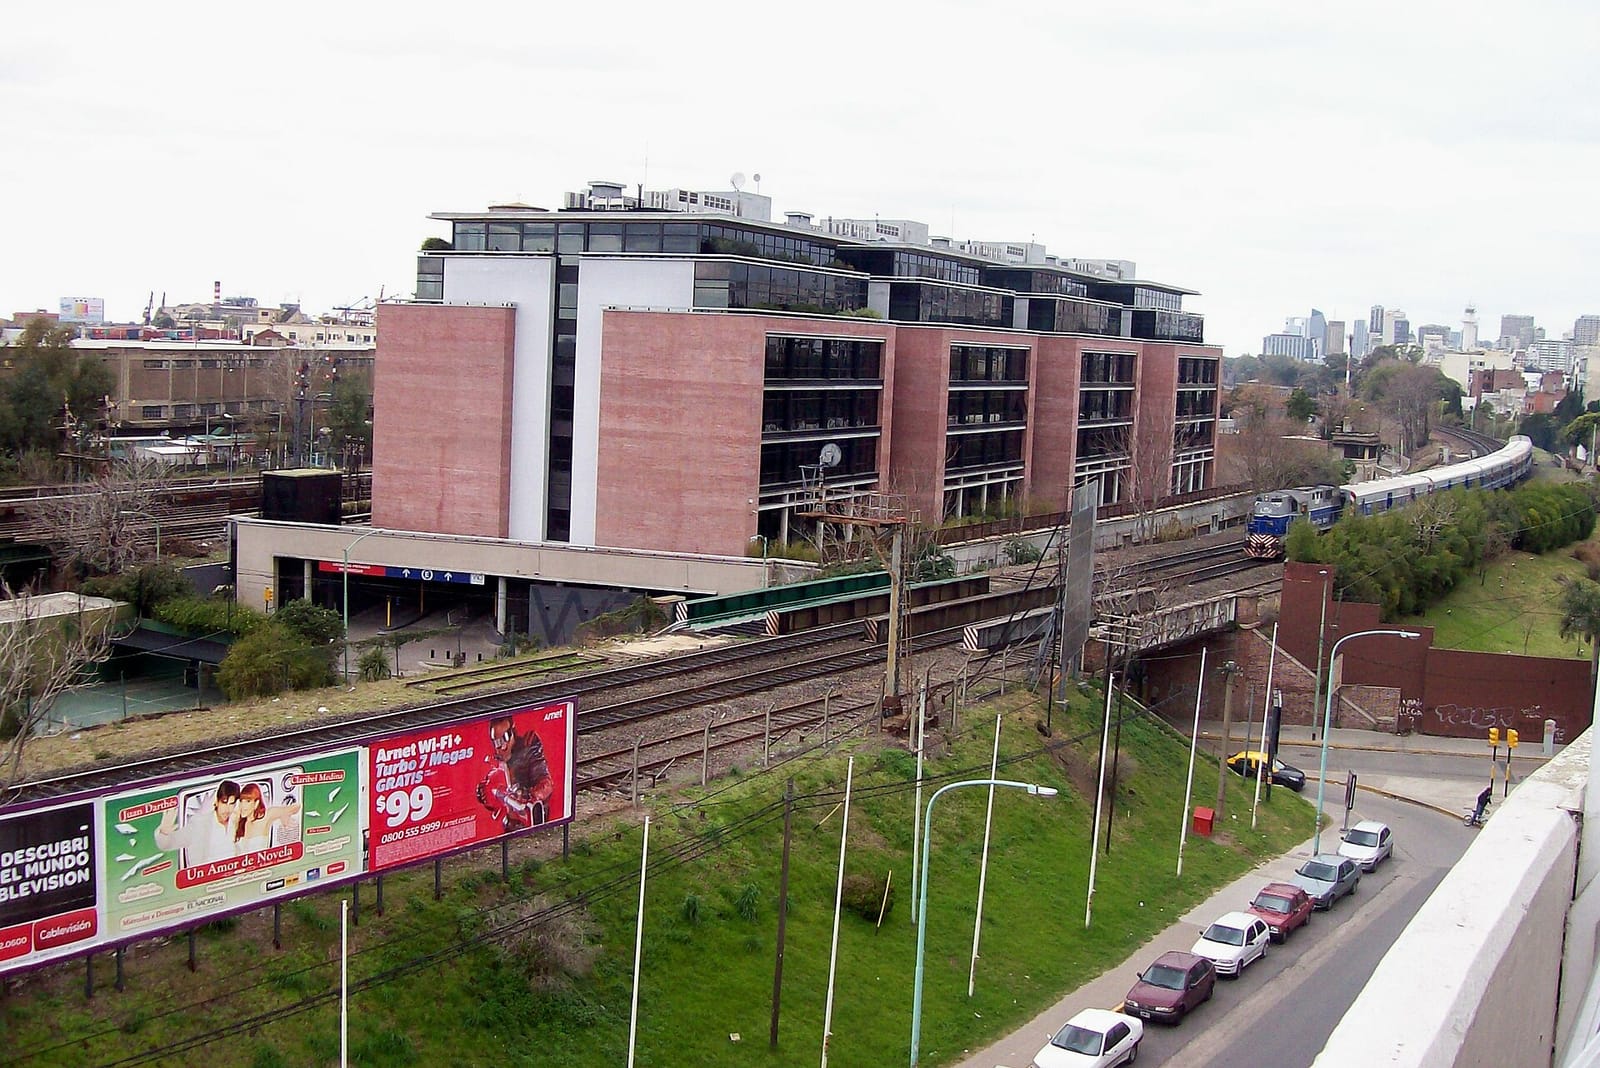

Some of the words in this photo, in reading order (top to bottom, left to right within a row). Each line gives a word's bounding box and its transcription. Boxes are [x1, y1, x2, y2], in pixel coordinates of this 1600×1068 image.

[376, 742, 416, 763] Arnet
[418, 734, 453, 754] Wi-Fi
[376, 758, 417, 777] Turbo
[418, 754, 428, 769] 7
[429, 747, 474, 767] Megas
[291, 774, 318, 785] Claribel
[319, 773, 344, 782] Medina
[375, 770, 424, 793] GRATIS
[122, 808, 143, 821] Juan
[144, 797, 178, 814] Darthés
[376, 785, 433, 828] $99
[381, 830, 404, 844] 0800
[404, 826, 420, 838] 555
[420, 820, 441, 834] 9999
[1, 835, 89, 868] DESCUBRI
[187, 868, 204, 881] Un
[208, 861, 239, 876] Amor
[241, 854, 254, 867] de
[257, 845, 293, 864] Novela
[0, 867, 22, 885] EL
[25, 851, 89, 879] MUNDO
[0, 867, 90, 903] BLEVISION
[40, 919, 92, 941] Cablevisión
